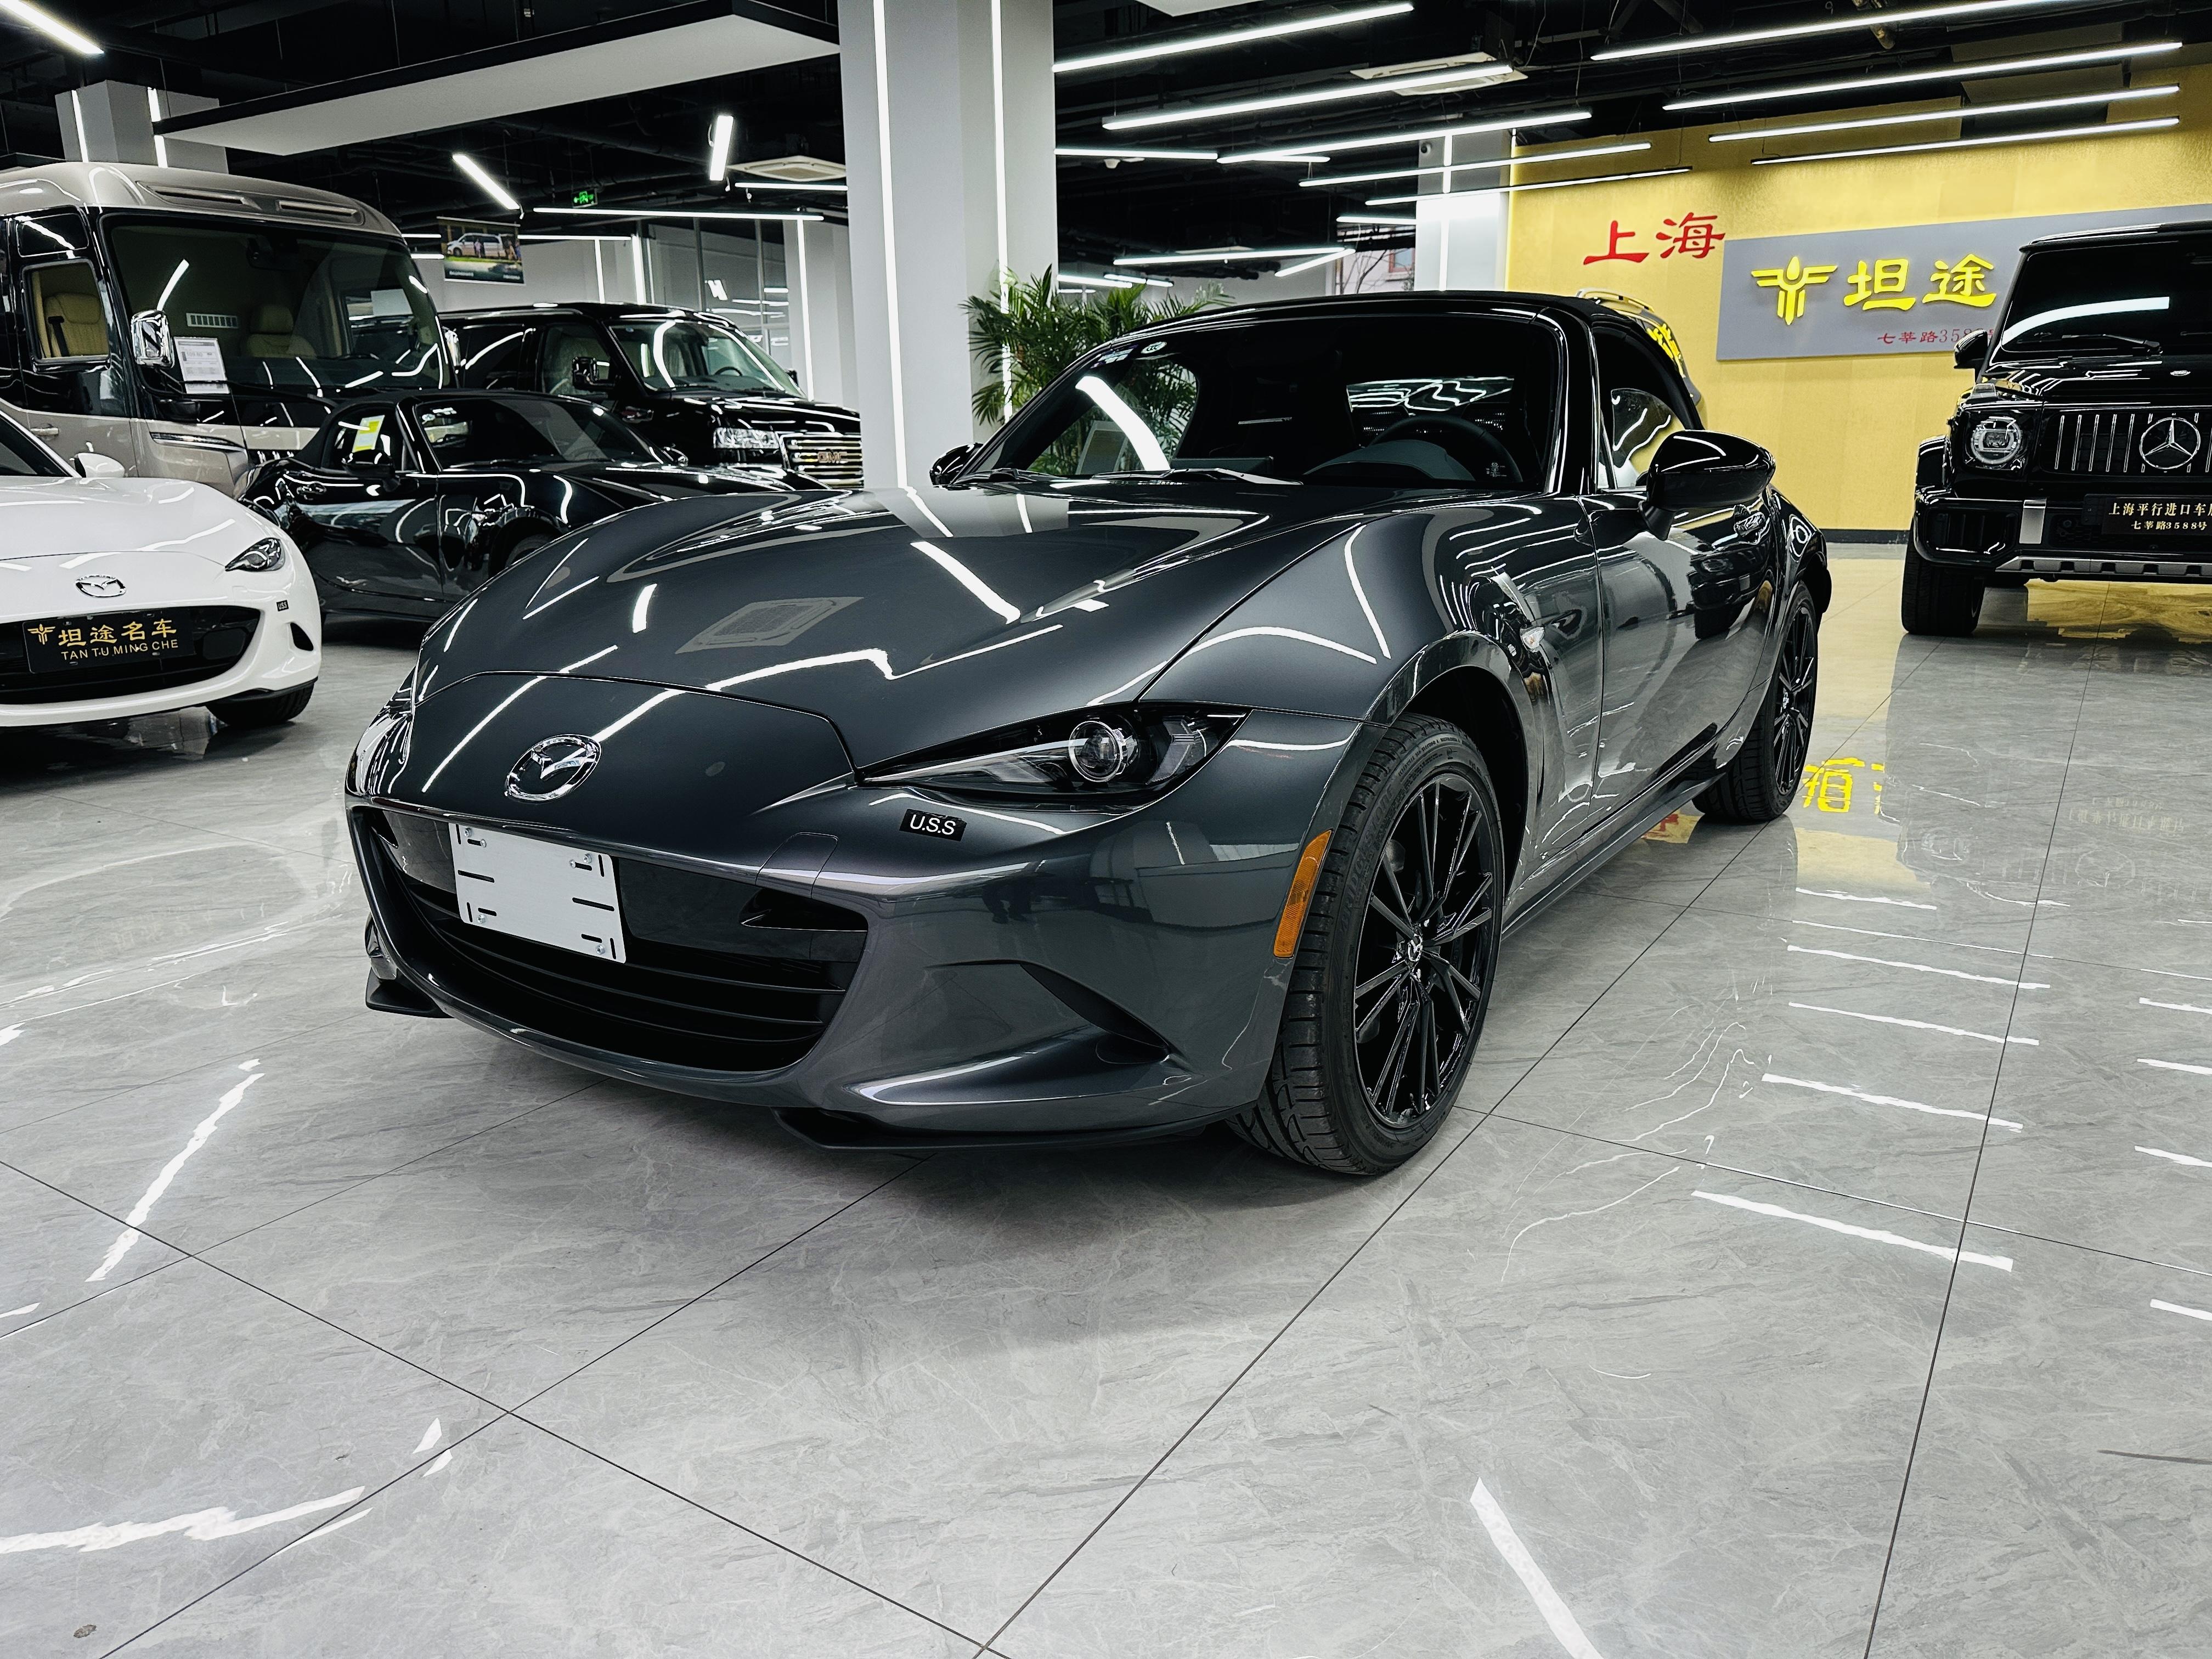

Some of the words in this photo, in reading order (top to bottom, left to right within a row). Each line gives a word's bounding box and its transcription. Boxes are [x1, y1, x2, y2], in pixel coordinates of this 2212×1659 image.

[1583, 212, 1726, 267] 上海
[1843, 253, 1997, 311] 坦途
[1877, 328, 1994, 344] 七莘路358
[58, 618, 177, 647] 坦途名车
[61, 649, 88, 661] TAN
[92, 646, 109, 657] TU
[114, 642, 148, 655] MING
[151, 639, 179, 650] CHE
[910, 814, 956, 835] U.S.S
